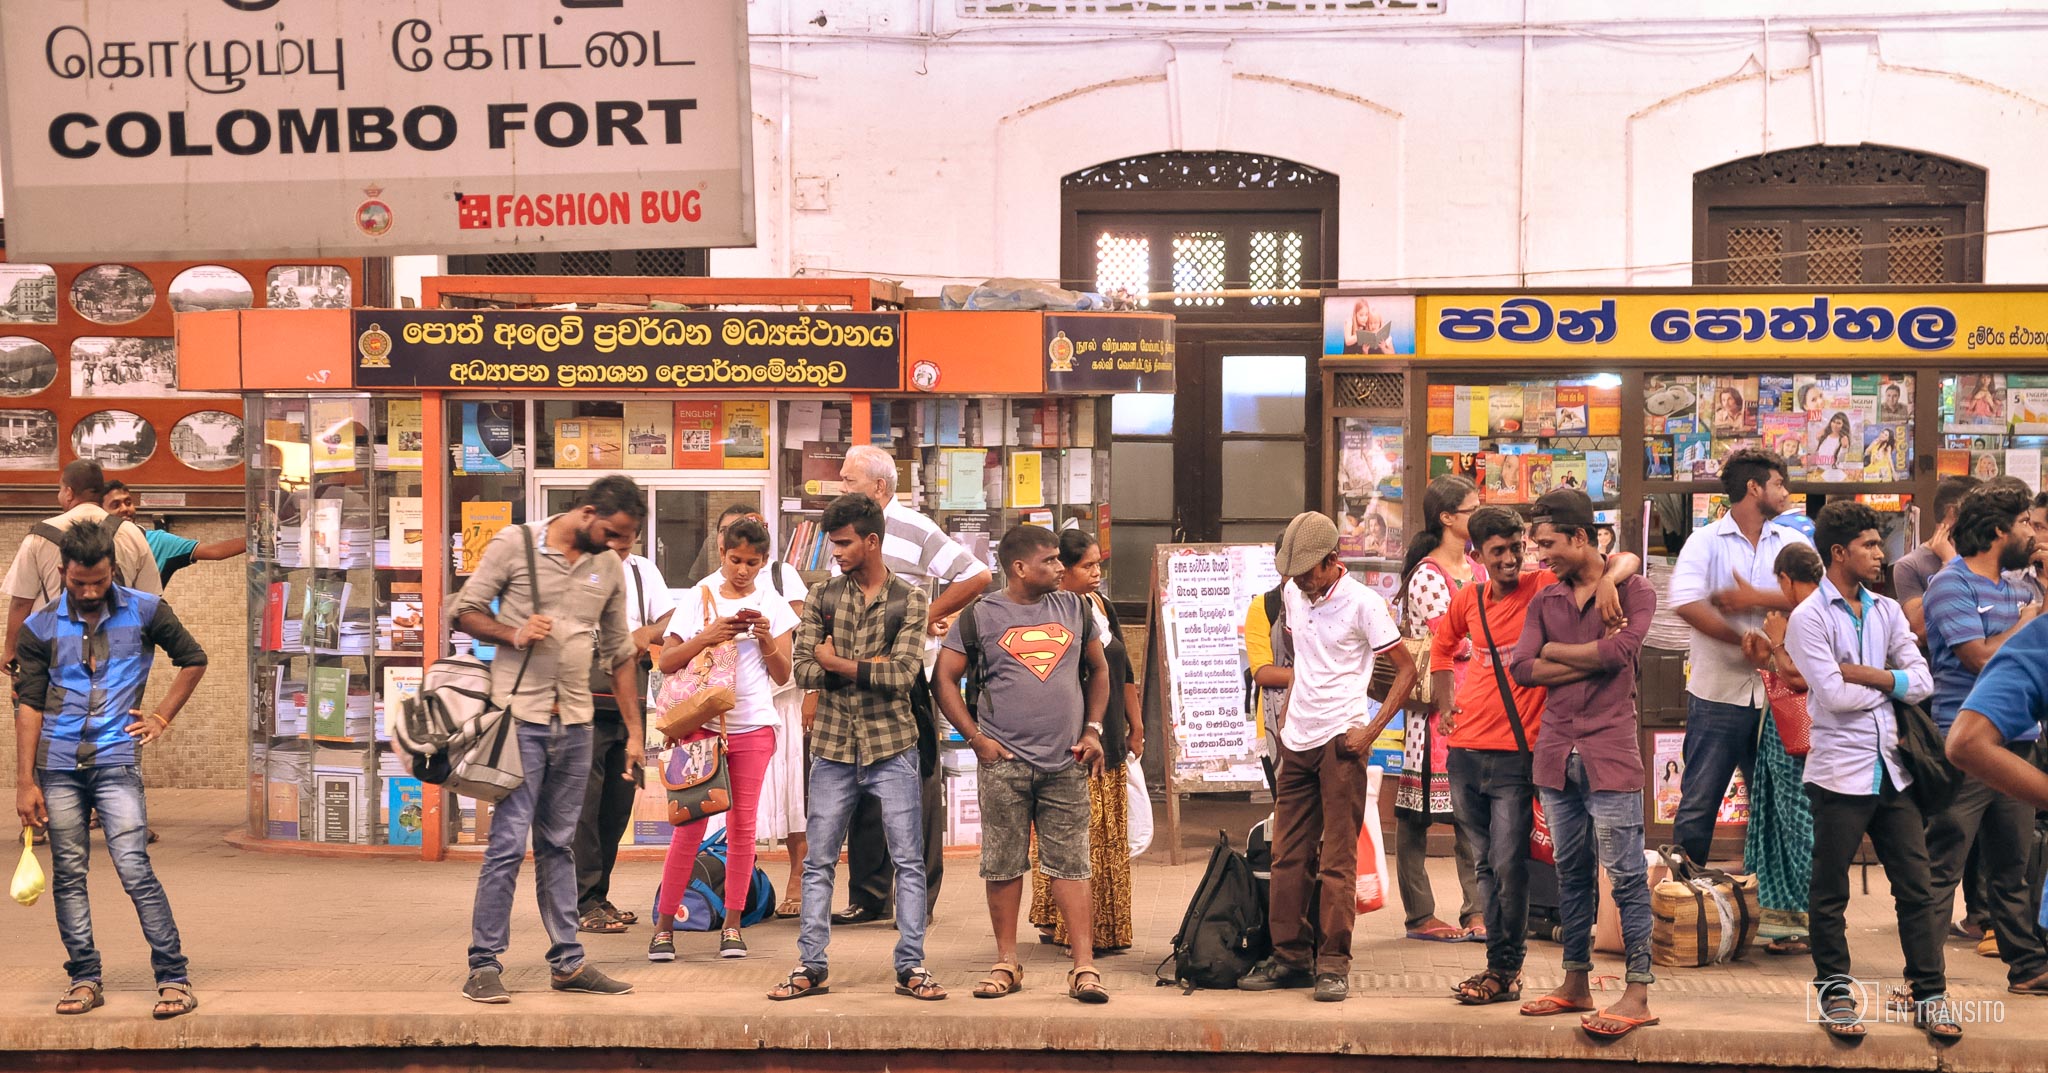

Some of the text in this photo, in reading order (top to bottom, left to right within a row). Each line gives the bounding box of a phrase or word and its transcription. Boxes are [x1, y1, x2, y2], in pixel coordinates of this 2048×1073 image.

[45, 15, 696, 94] கொழும்பு கோட்டை
[48, 98, 697, 159] COLOMBO FORT
[497, 190, 702, 228] FASHION BUG
[402, 314, 484, 345] පොත්
[493, 315, 584, 352] අලෙවි
[1437, 295, 1957, 351] පවන් පොත්හල
[1967, 325, 2005, 349] දුම්රිය
[655, 358, 848, 387] දෙපාර්තමේන්තුව
[680, 410, 716, 418] ENGLISH
[473, 526, 481, 537] 7
